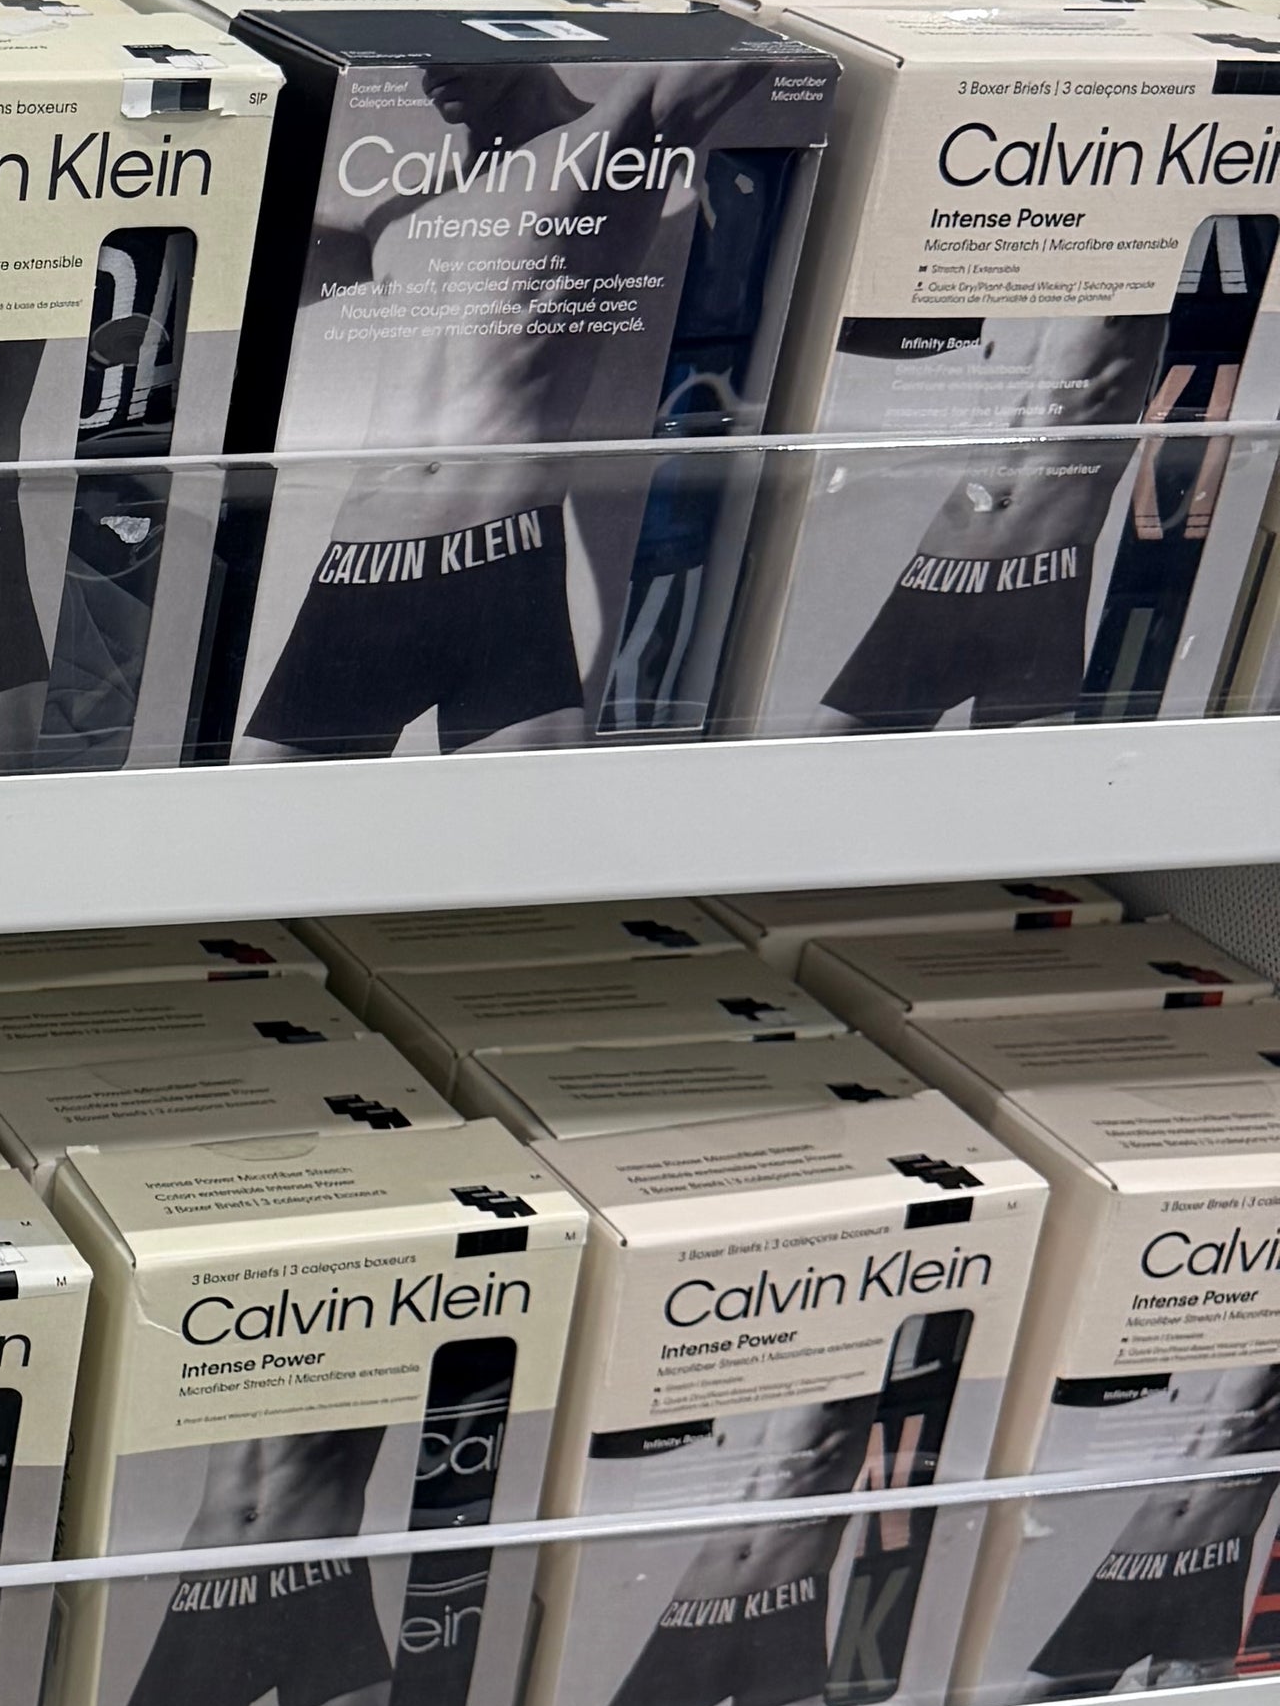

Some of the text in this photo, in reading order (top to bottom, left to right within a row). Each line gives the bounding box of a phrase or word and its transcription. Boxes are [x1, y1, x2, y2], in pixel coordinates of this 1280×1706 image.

[17, 101, 77, 114] boxeurs
[48, 132, 211, 200] Klein
[339, 130, 696, 197] Calvin Klein
[939, 123, 1143, 187] Calvin
[407, 211, 608, 240] Intense Power
[1141, 1227, 1280, 1278] Calvi
[182, 1272, 530, 1345] Calvin Klein
[665, 1247, 991, 1327] Calvin Klein
